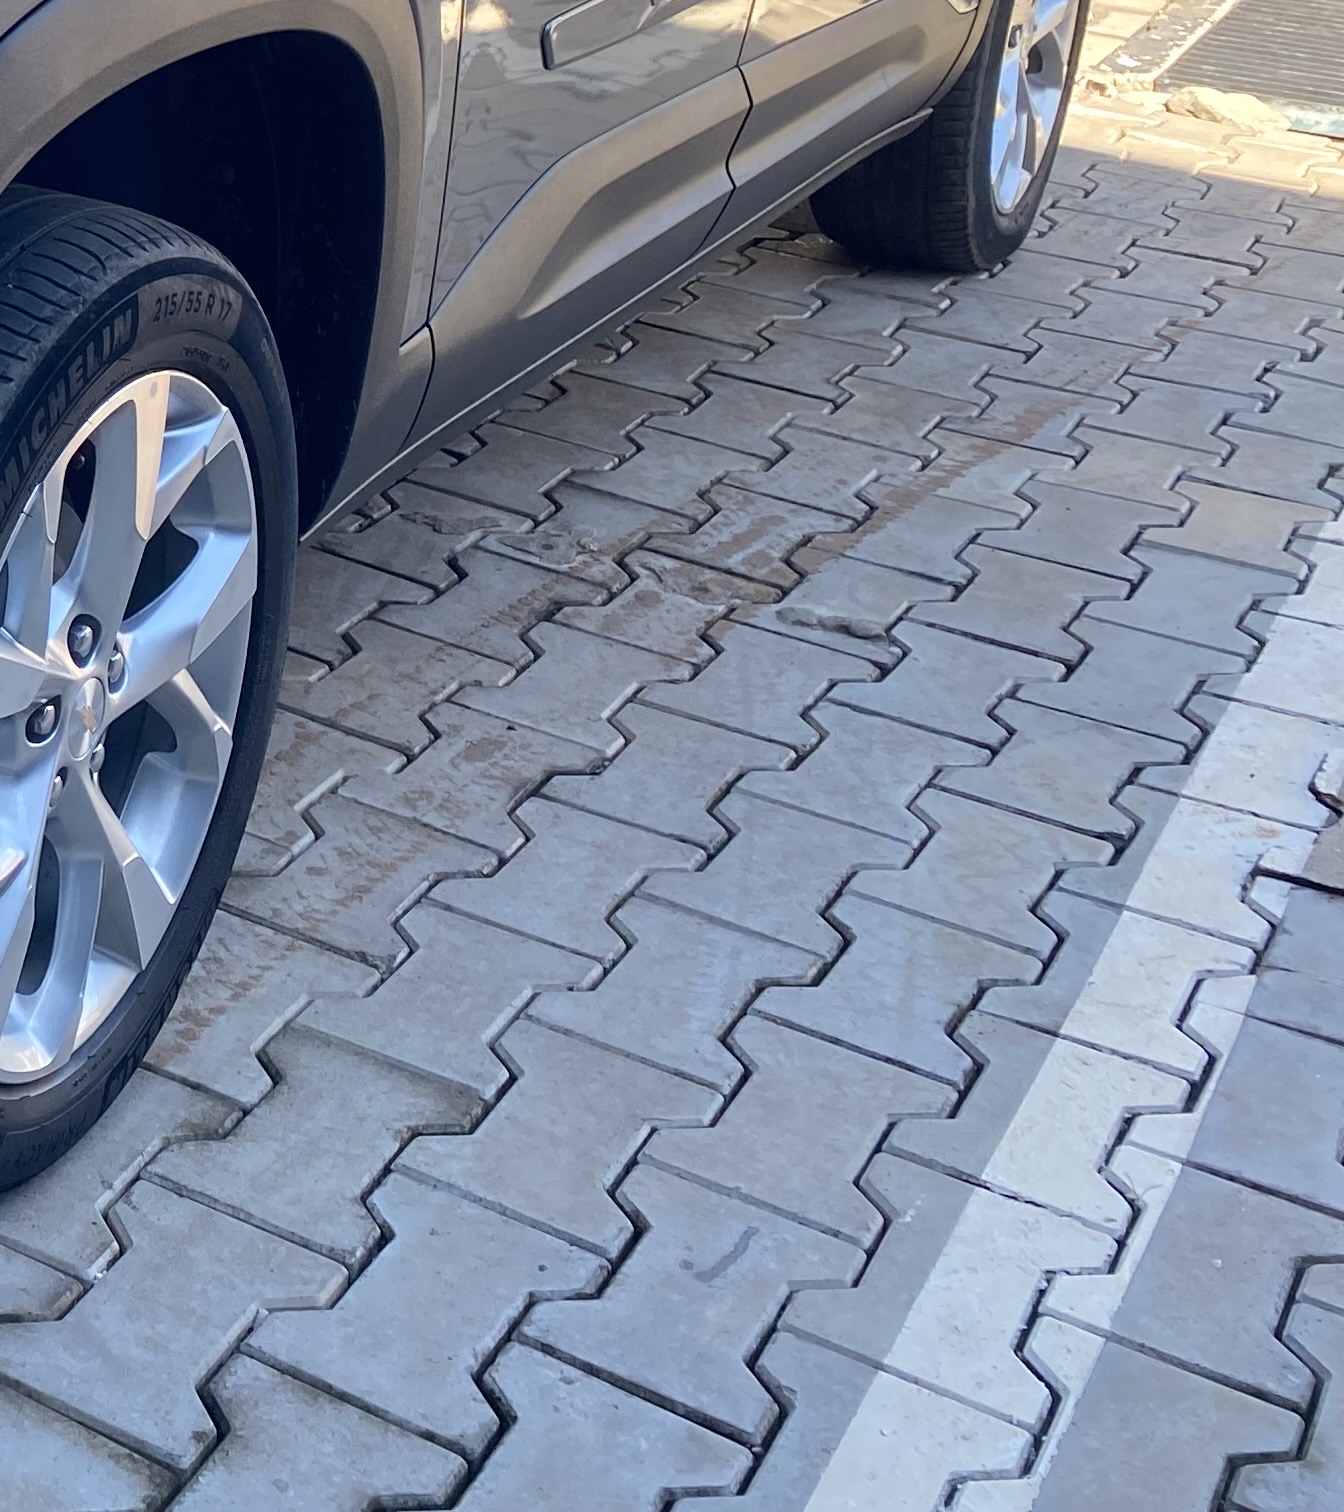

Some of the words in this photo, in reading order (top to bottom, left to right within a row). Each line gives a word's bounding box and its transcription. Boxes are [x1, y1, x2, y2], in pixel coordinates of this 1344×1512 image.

[153, 290, 203, 324] 215/55
[205, 292, 216, 316] R
[217, 300, 234, 322] 17
